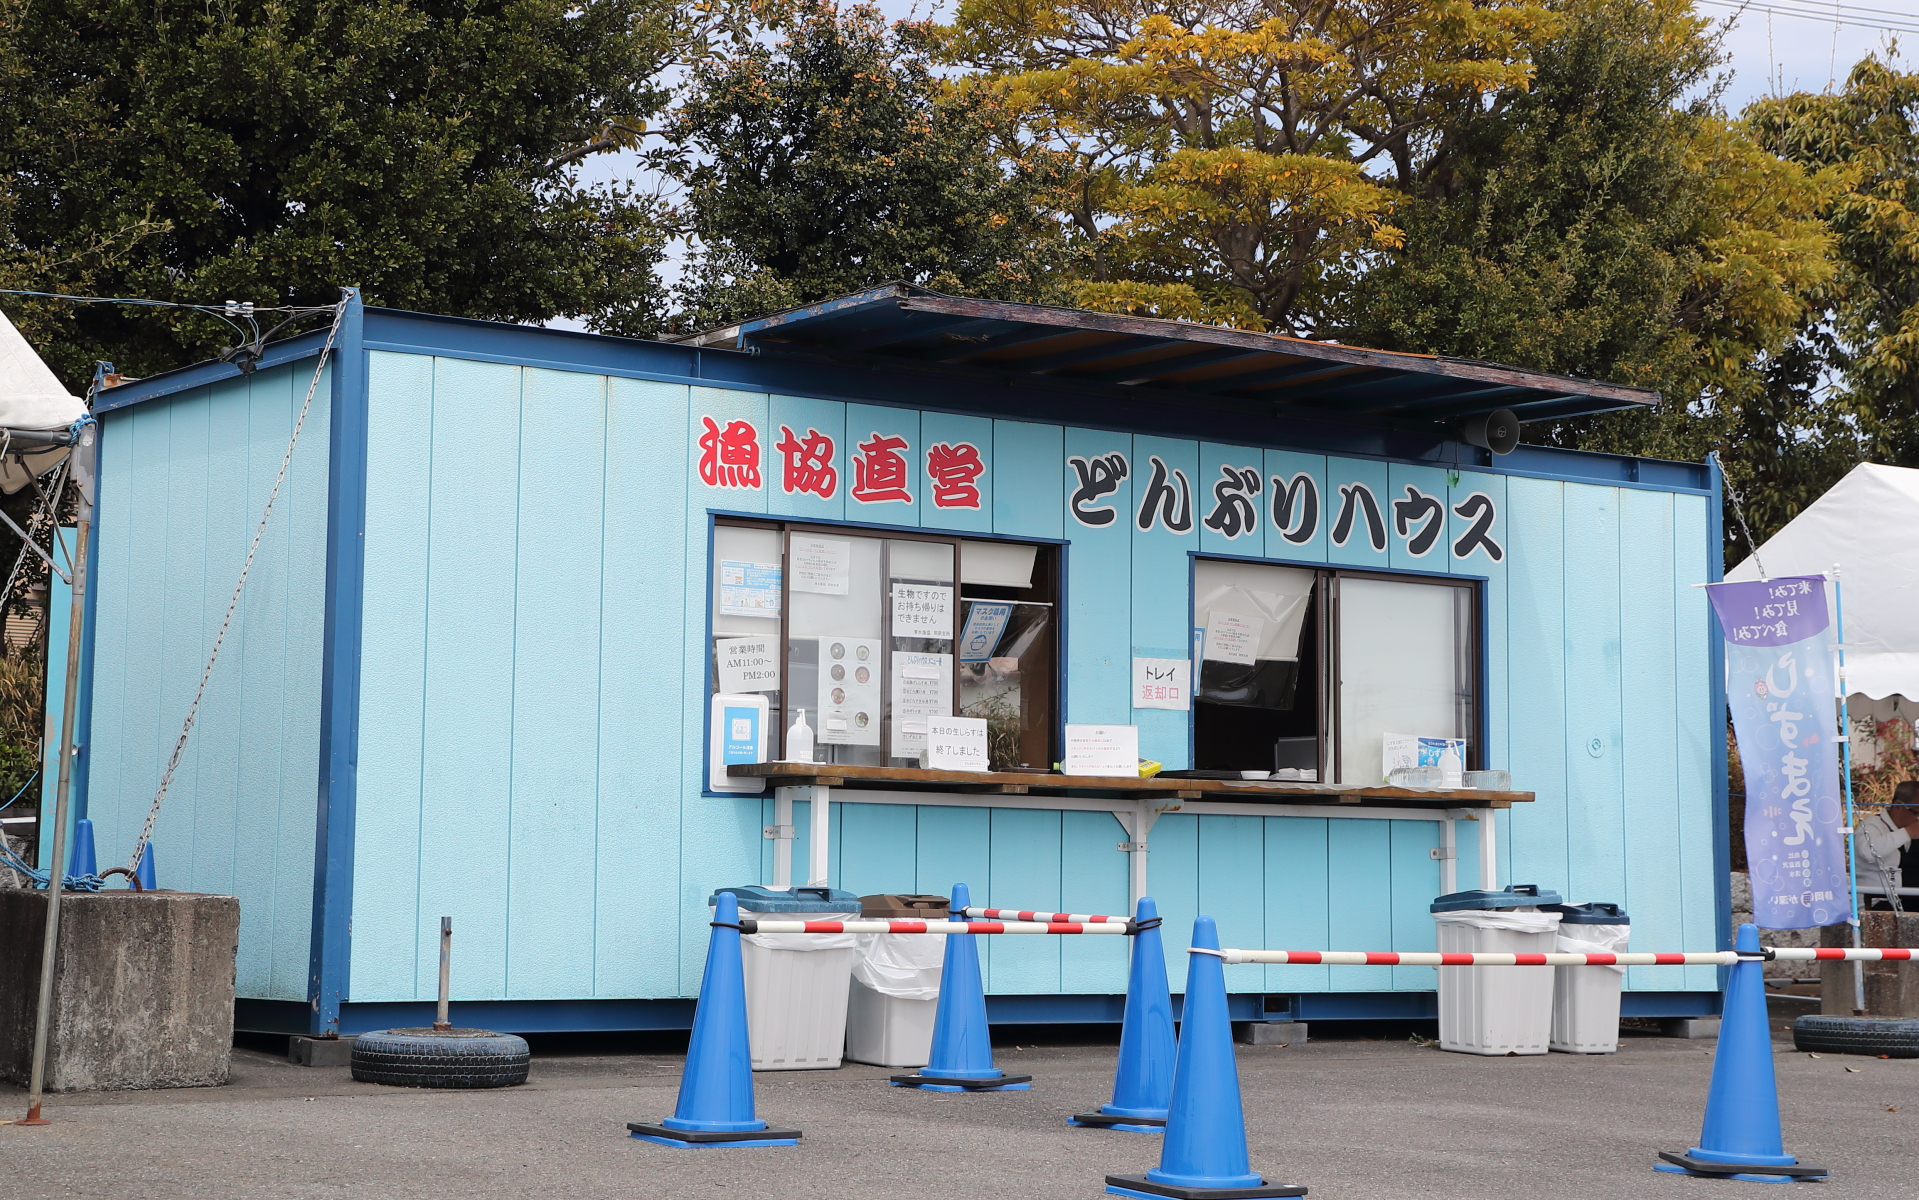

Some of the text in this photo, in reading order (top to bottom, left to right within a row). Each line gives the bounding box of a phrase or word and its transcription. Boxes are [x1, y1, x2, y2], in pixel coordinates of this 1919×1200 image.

[698, 416, 985, 509] 漁協直営
[1068, 452, 1504, 562] どんぶりハウス
[897, 589, 947, 601] 生物ですので
[897, 601, 945, 613] お持ち帰りは
[897, 613, 937, 625] できません
[728, 643, 765, 655] 営業時間
[743, 670, 776, 680] PM2:00
[1146, 666, 1175, 681] トレイ
[1142, 685, 1179, 700] 返却口
[931, 727, 984, 737] 本日の生しらすは
[935, 745, 981, 757] 終了しました
